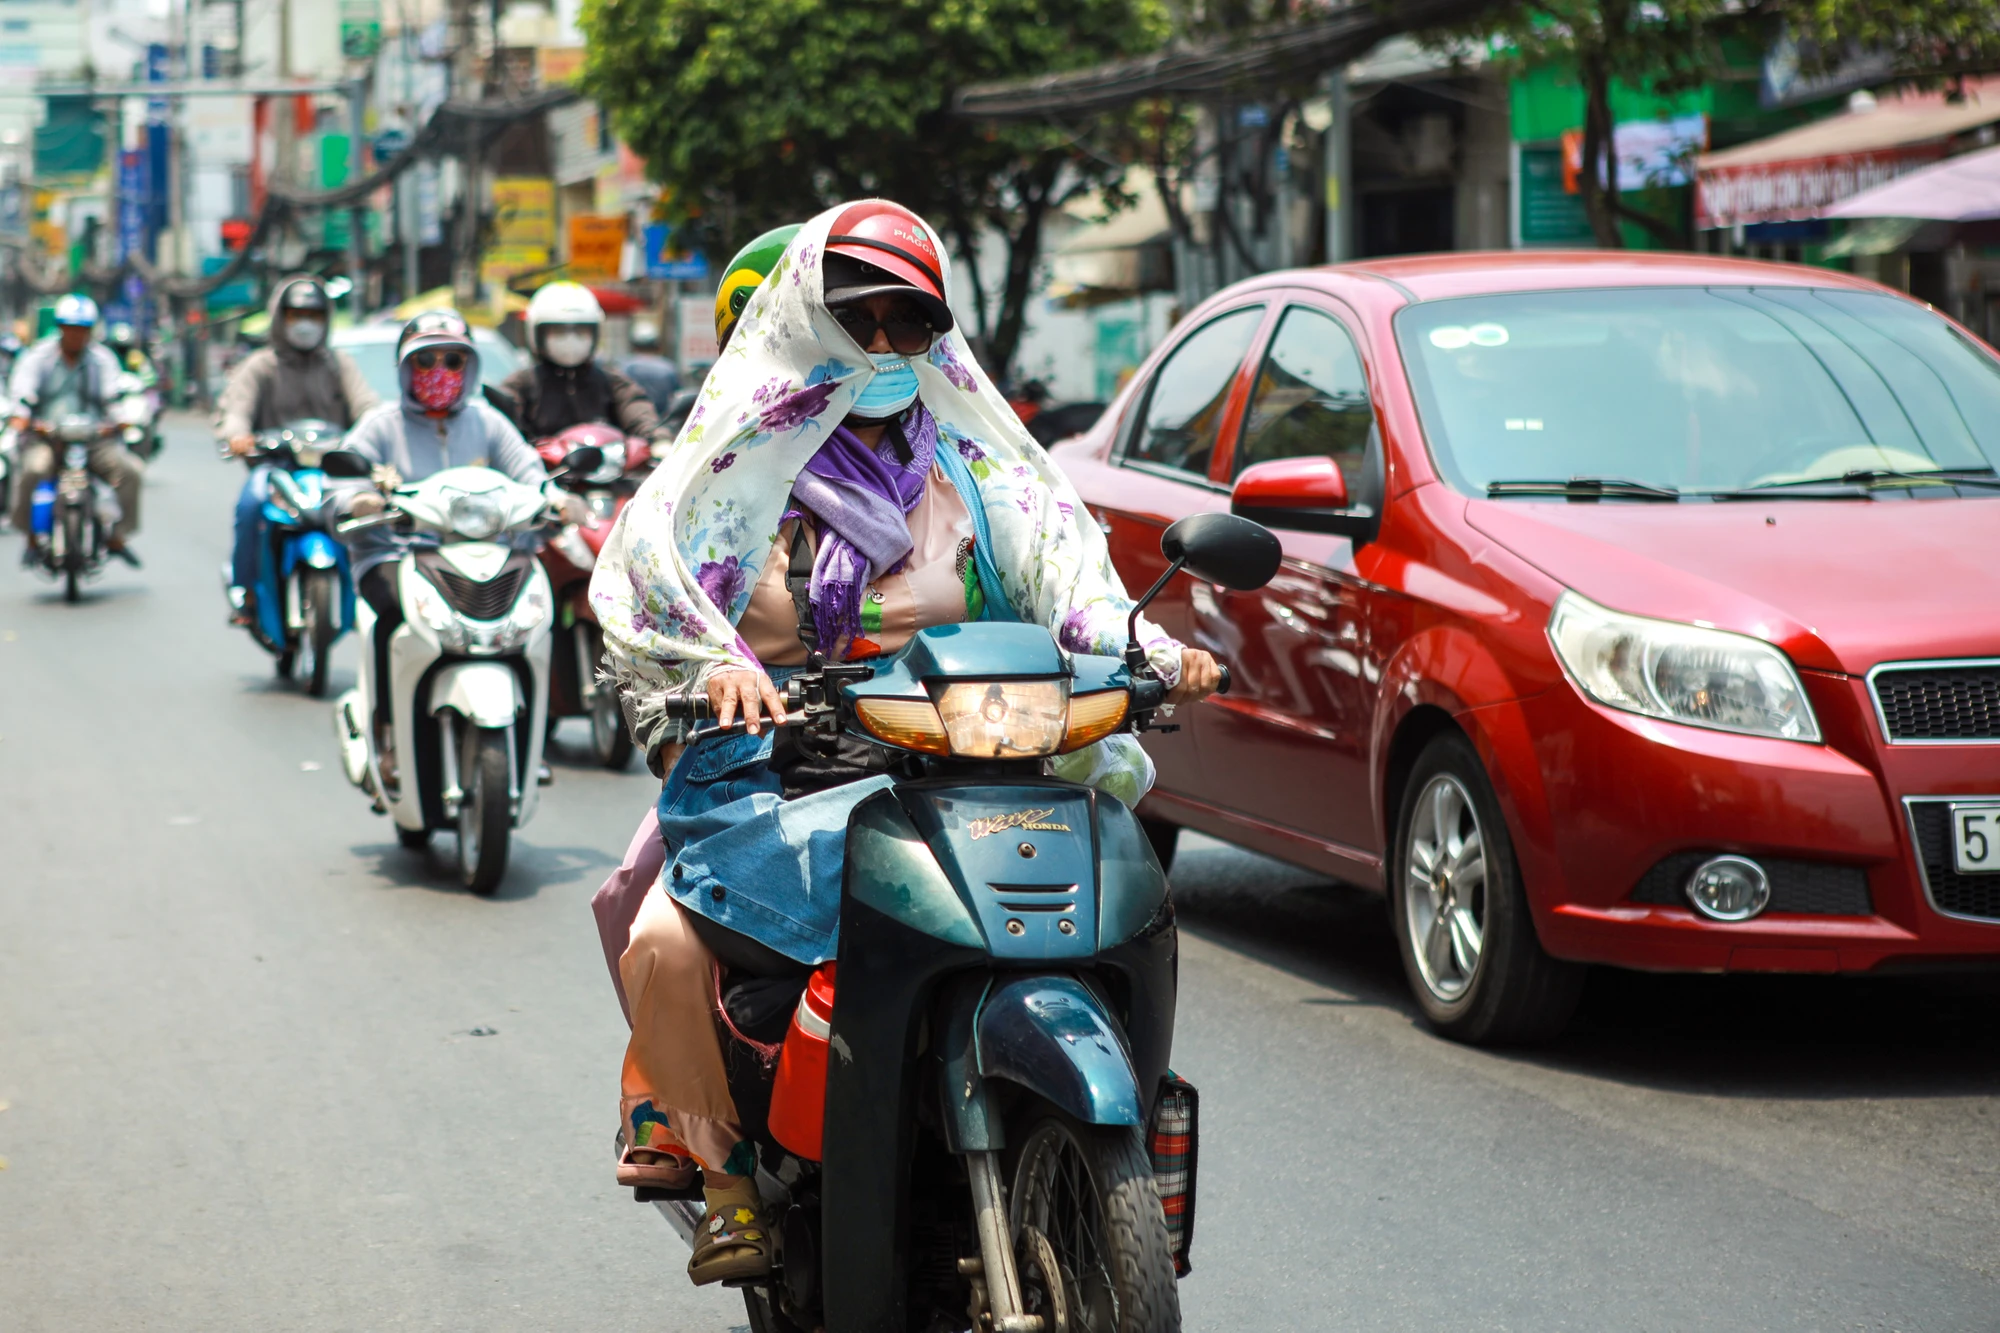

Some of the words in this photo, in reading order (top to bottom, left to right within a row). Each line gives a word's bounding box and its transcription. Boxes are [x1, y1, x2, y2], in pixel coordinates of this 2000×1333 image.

[893, 228, 939, 261] PIAGGIO
[966, 806, 1055, 841] Wave
[1020, 822, 1072, 832] HONDA
